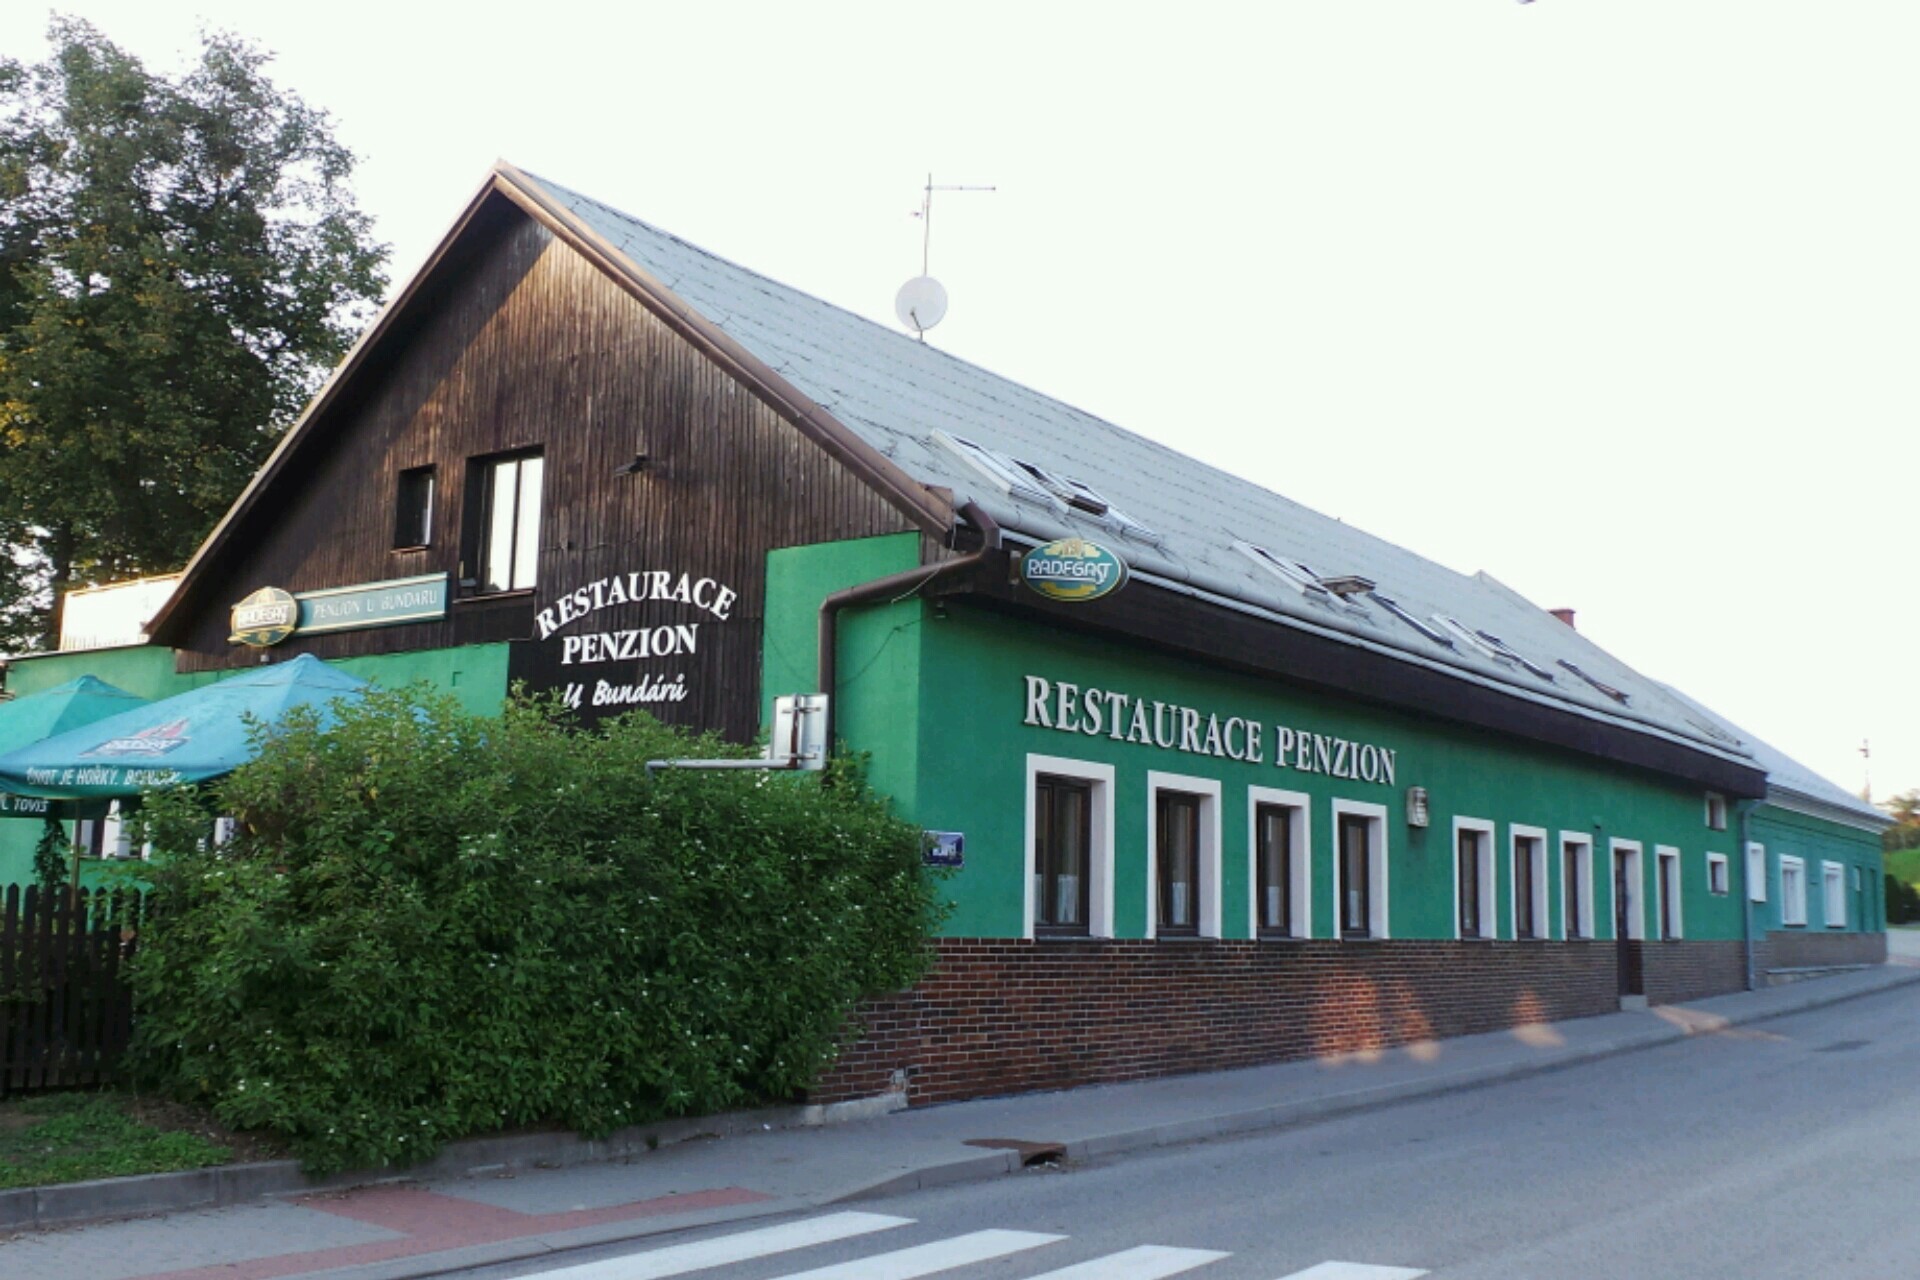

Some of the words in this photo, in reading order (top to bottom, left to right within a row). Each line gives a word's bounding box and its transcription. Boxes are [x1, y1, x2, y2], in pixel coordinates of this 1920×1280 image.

[1027, 559, 1112, 585] RADEGAST
[535, 571, 737, 640] RESTAURACE
[561, 623, 699, 665] PENZION
[1023, 675, 1263, 763] RESTAURACE
[1275, 725, 1397, 786] PENZION
[58, 769, 76, 785] JE
